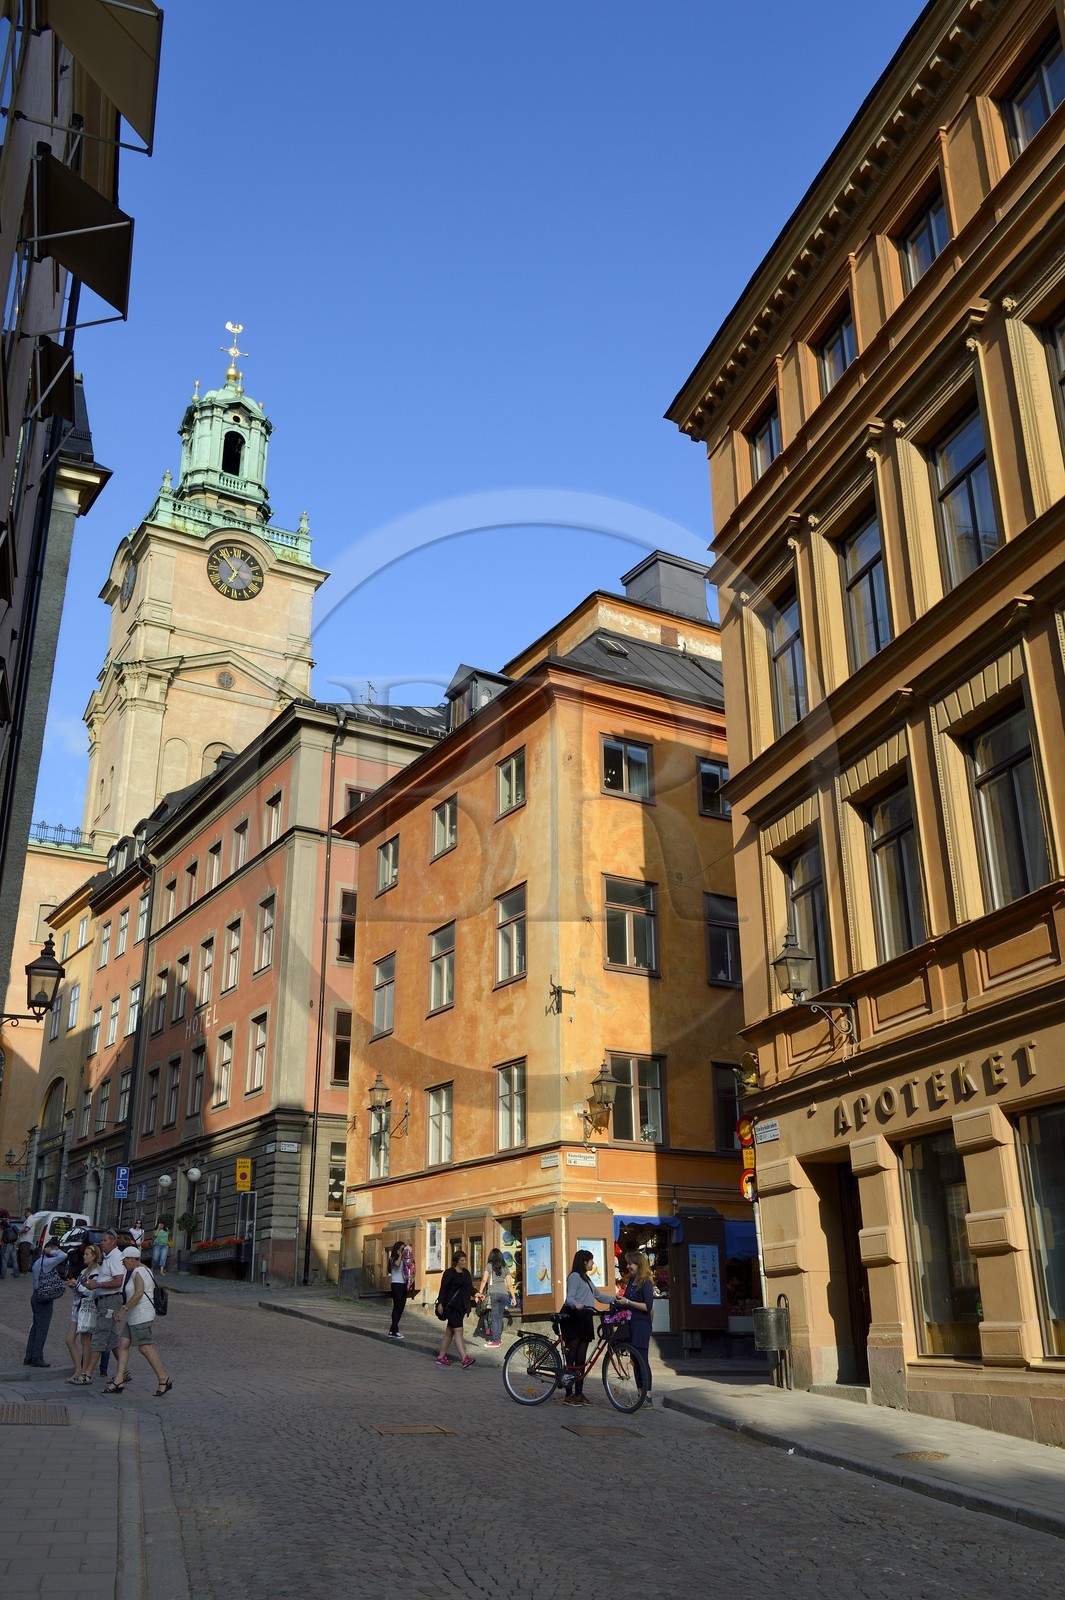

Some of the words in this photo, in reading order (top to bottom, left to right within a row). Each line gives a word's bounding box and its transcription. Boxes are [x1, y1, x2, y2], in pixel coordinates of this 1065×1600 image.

[233, 548, 241, 558] XII
[185, 1004, 218, 1039] HOTEL
[835, 1040, 1037, 1133] APOTEKET
[120, 1169, 127, 1178] P
